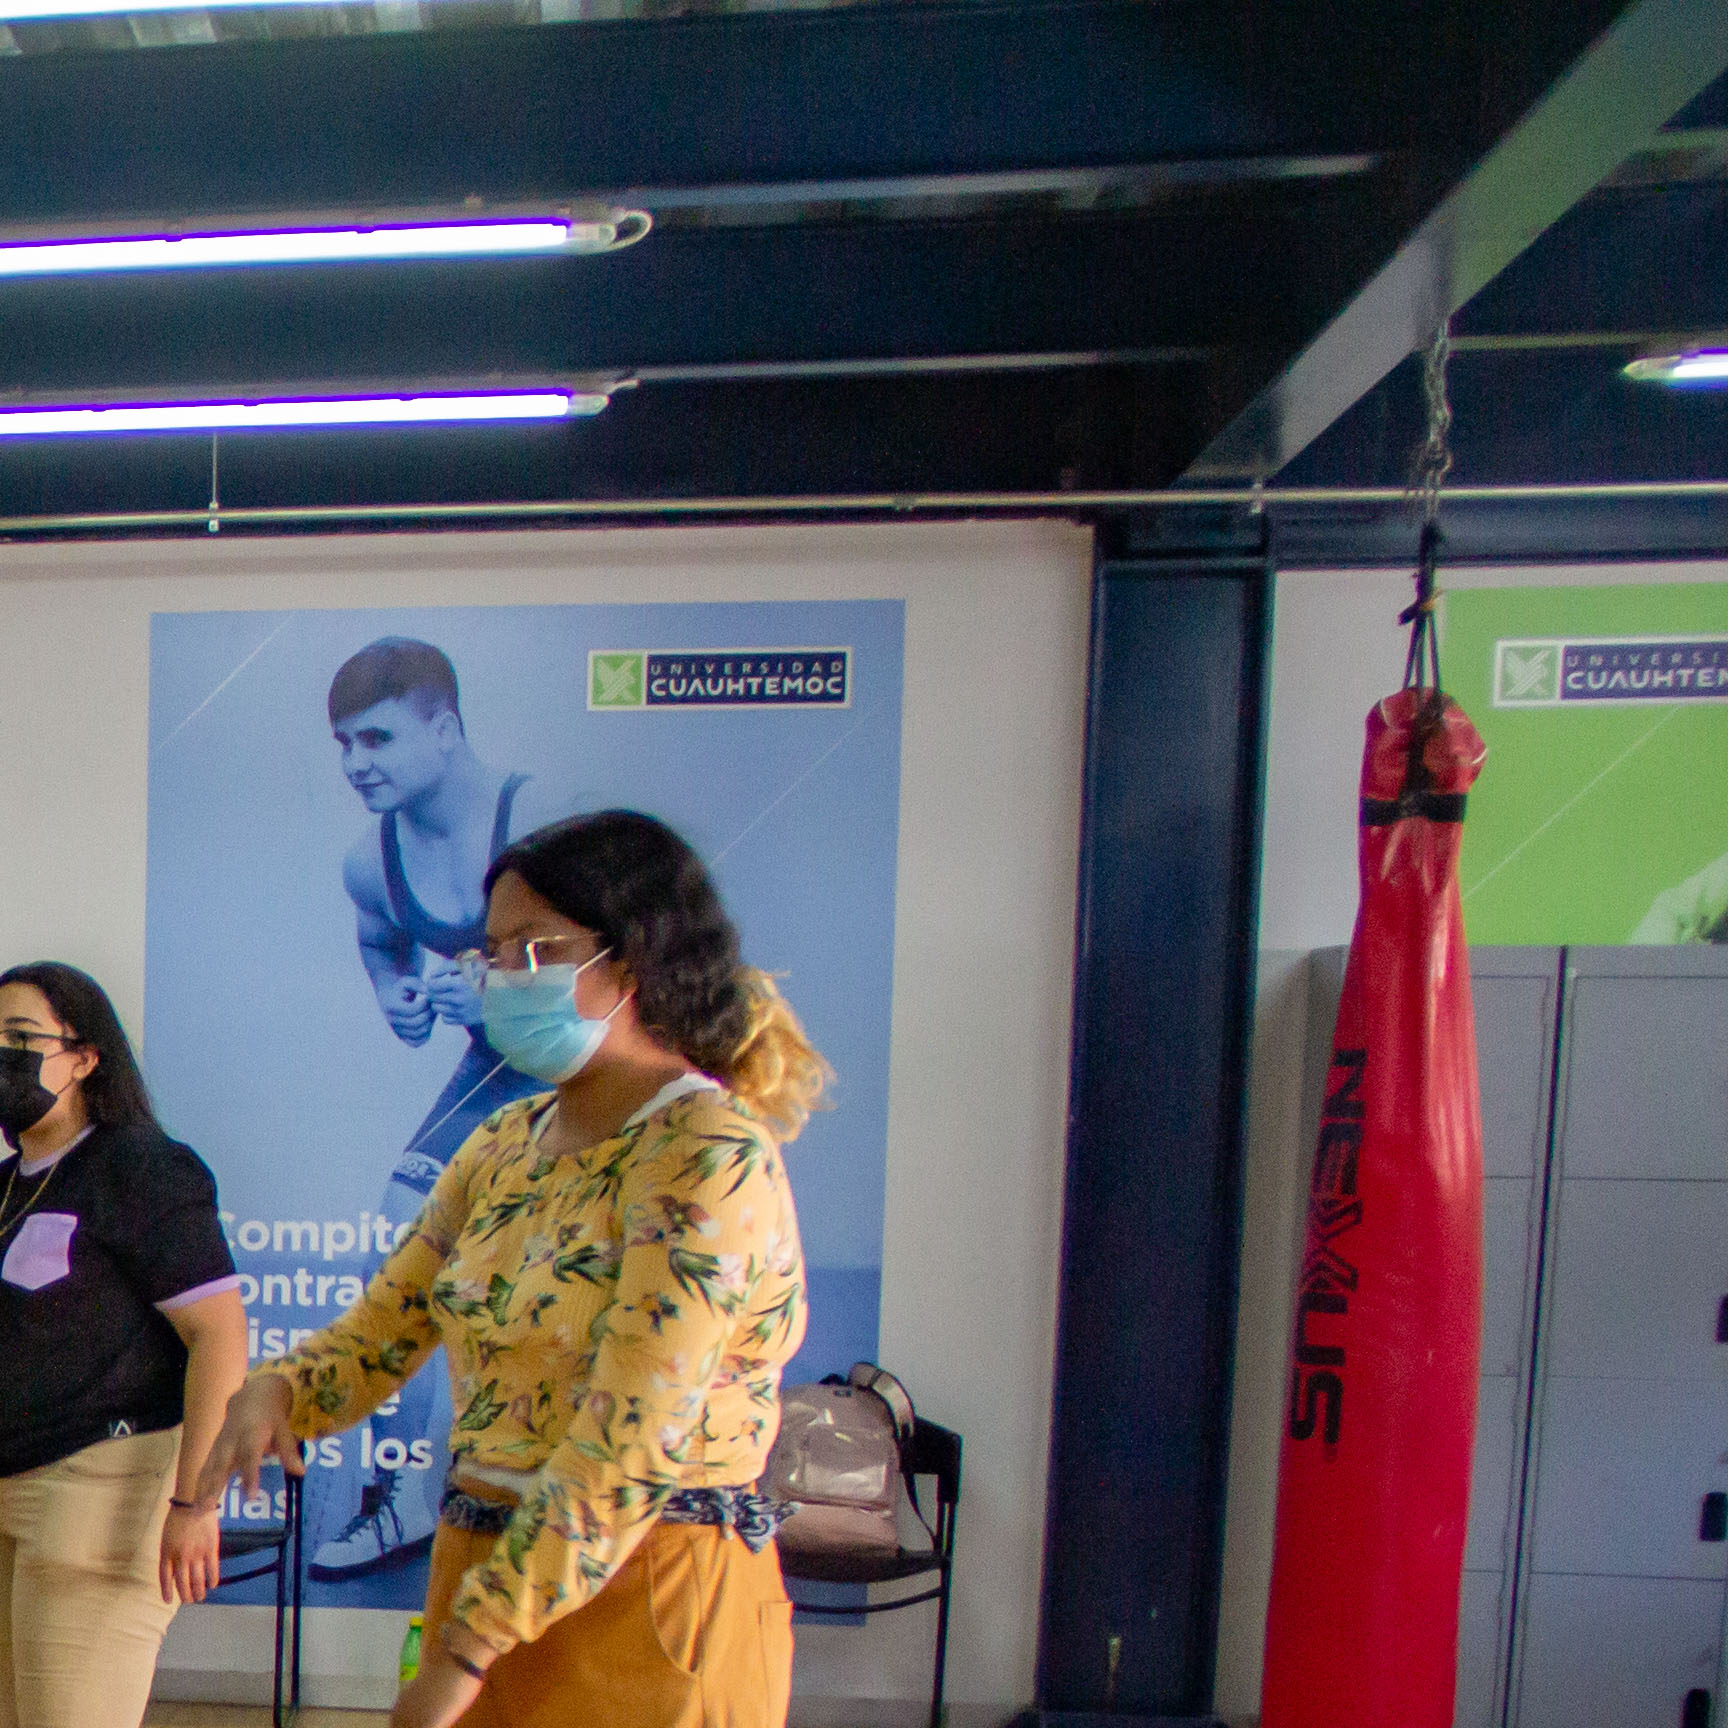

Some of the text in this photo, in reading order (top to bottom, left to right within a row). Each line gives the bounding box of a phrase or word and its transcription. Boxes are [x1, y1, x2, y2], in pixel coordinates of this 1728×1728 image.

[650, 662, 843, 676] UNIVERSIDAD
[1566, 652, 1728, 668] UNIVERSI
[650, 676, 843, 697] CUAUHTEMOC
[1290, 1047, 1368, 1446] NEXUS
[239, 1268, 363, 1306] ontra
[361, 1428, 433, 1470] los
